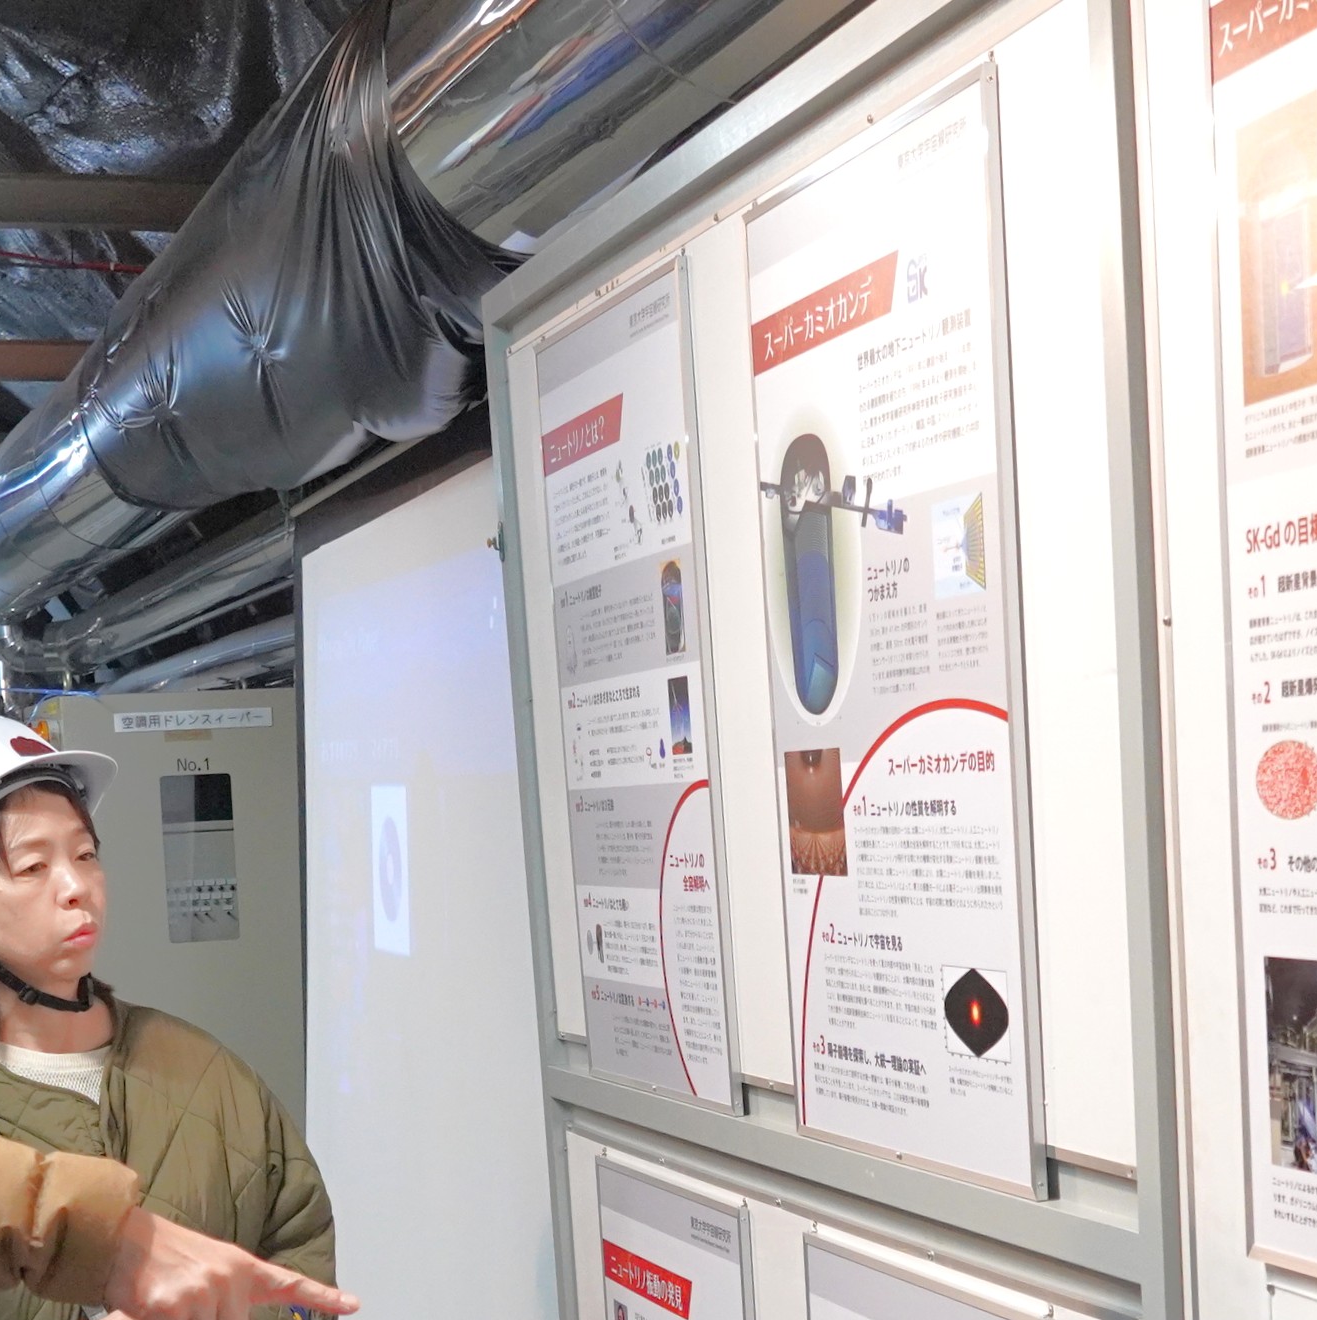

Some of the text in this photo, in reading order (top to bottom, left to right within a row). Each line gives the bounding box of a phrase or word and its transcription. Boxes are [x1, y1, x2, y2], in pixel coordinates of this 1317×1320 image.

[764, 276, 872, 361] スーパーカミオカンデ
[867, 557, 909, 581] ニュートリノの
[867, 581, 898, 602] つかまえ方
[177, 757, 211, 772] No.1
[888, 750, 995, 776] スーパーカミオカンデの目的
[610, 1255, 683, 1311] ニュートリノ振動の発見
